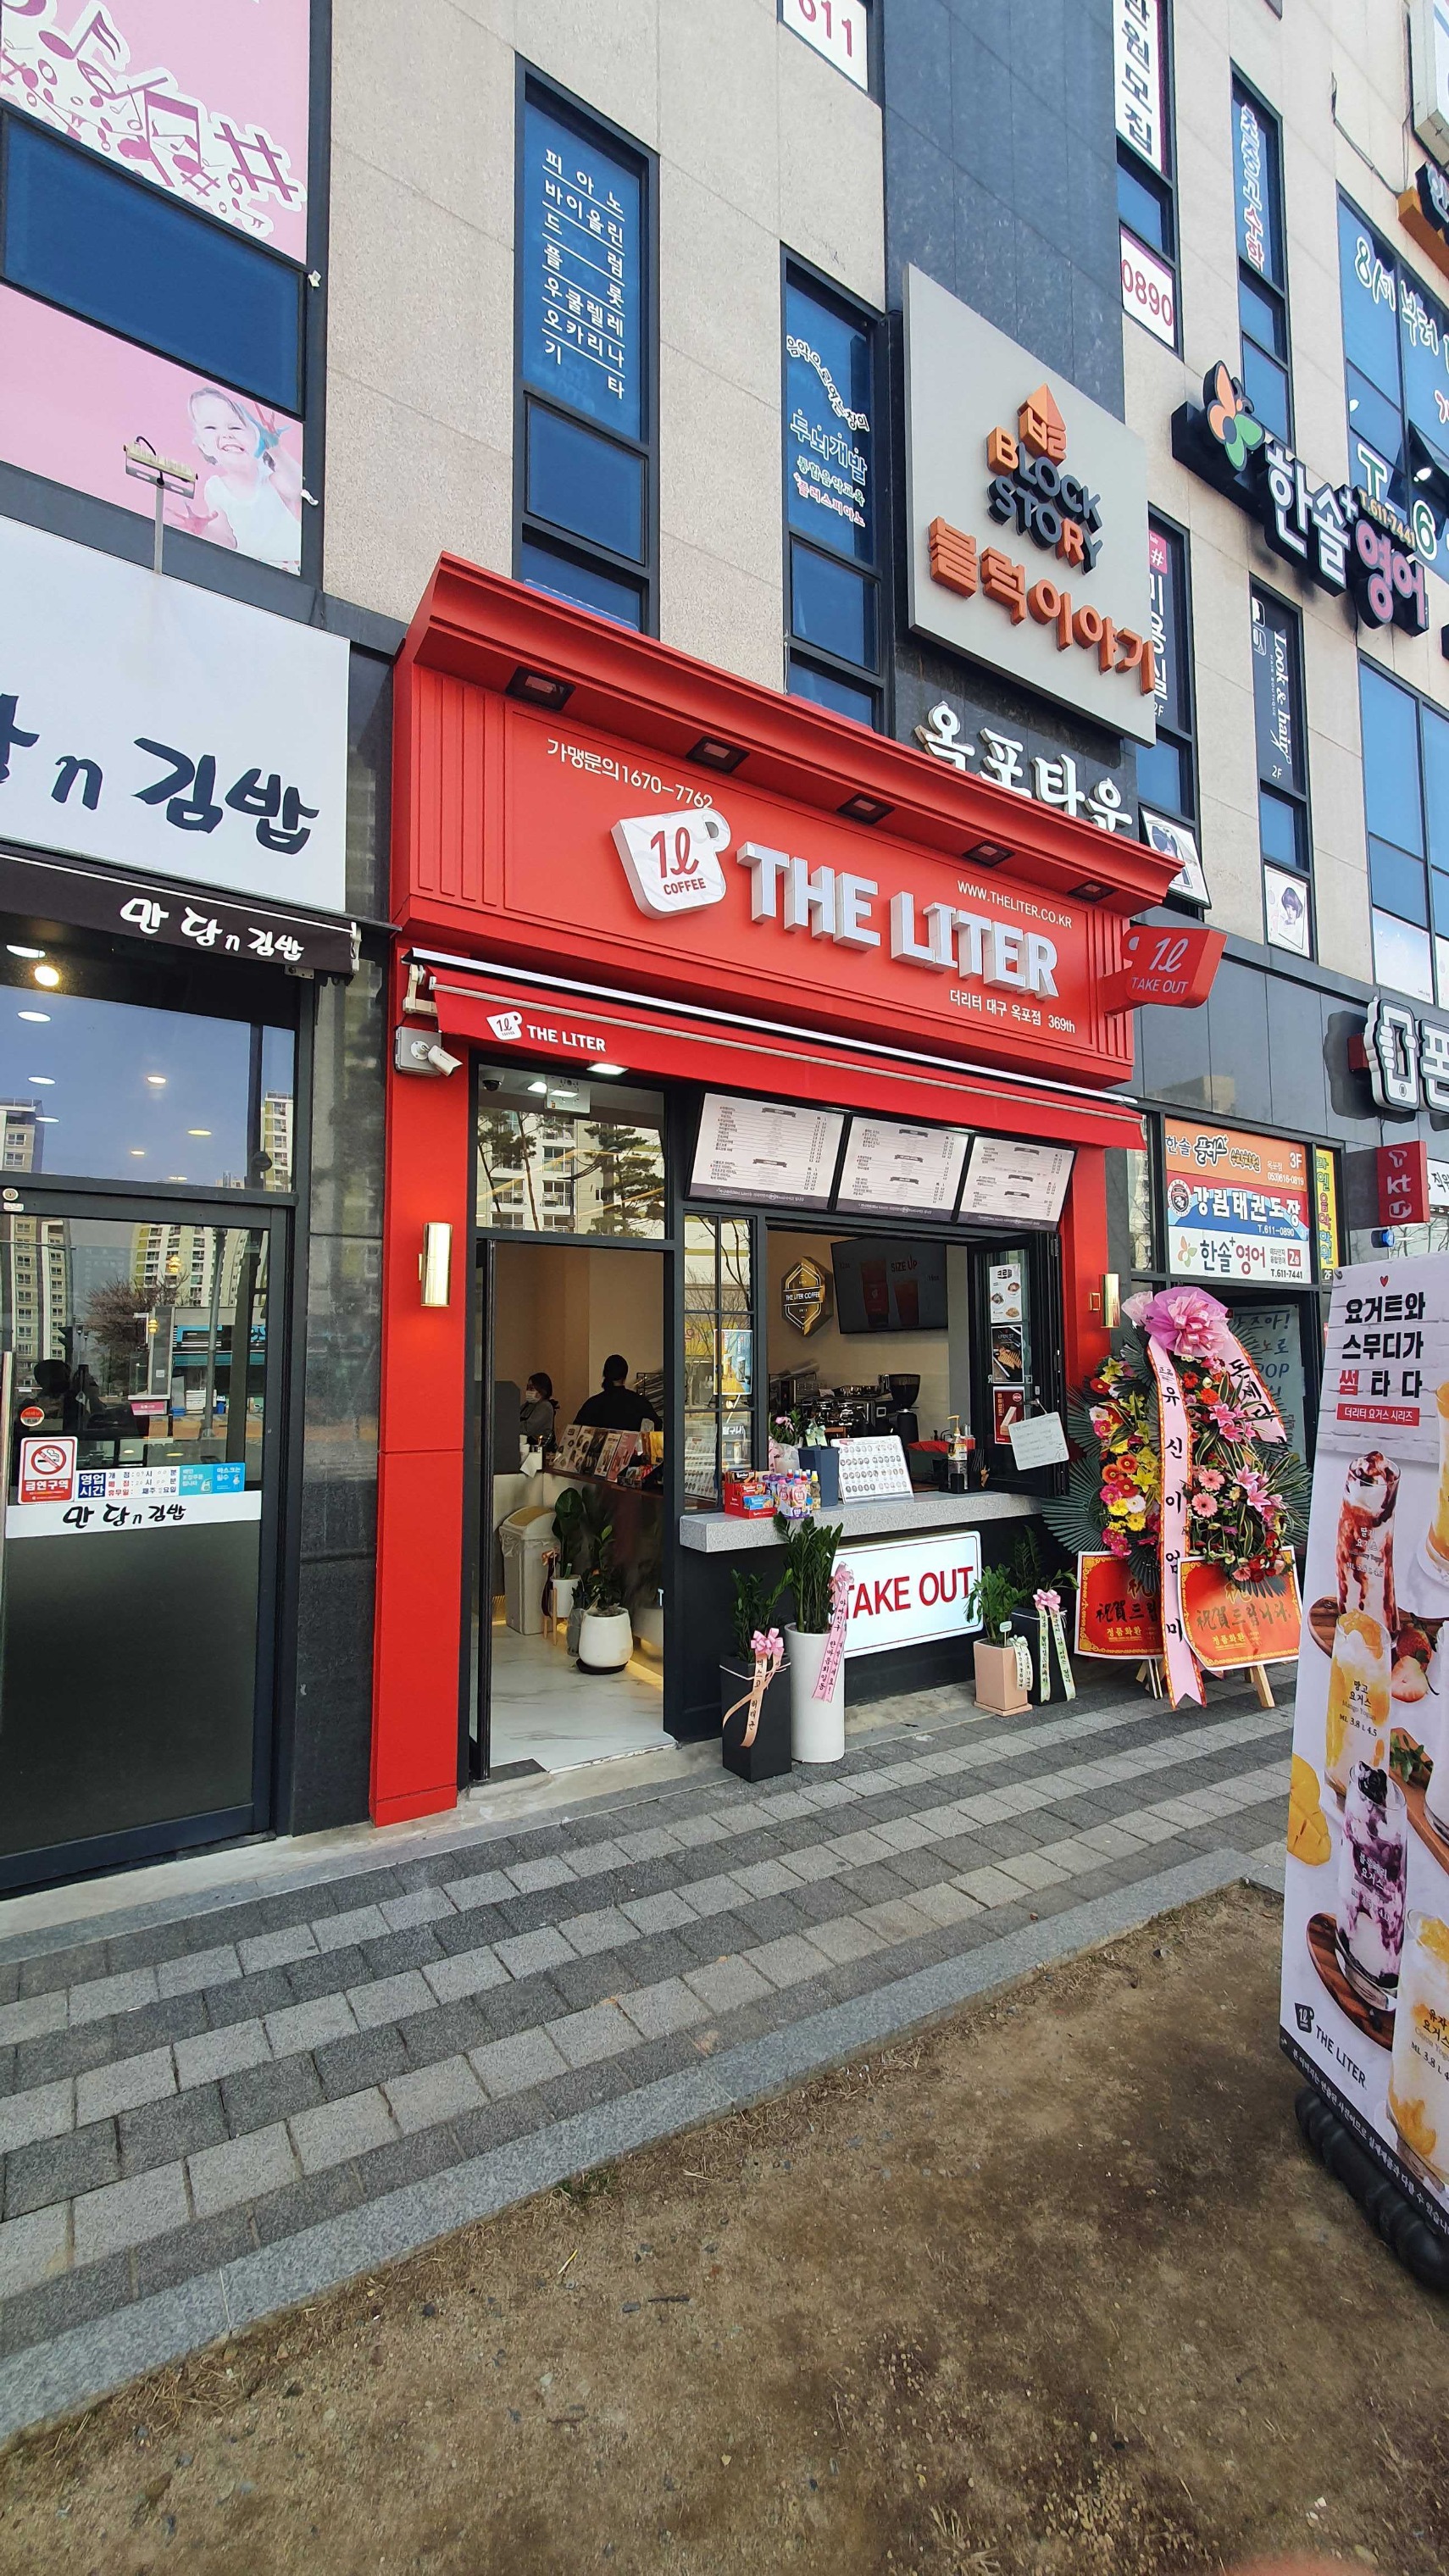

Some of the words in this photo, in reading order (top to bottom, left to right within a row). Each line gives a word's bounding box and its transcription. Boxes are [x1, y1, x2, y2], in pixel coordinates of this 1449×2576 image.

[545, 148, 624, 214] 피아노
[545, 180, 623, 247] 바이올린
[1121, 259, 1173, 327] 0890
[545, 310, 625, 369] 오카리나
[790, 408, 867, 486] 두뇌개발
[987, 426, 1102, 534] BLOCK
[988, 475, 1103, 575] STORY
[928, 516, 1155, 696] 블록이야기
[1274, 630, 1289, 686] Look
[1271, 765, 1283, 779] 2F
[131, 737, 320, 855] 김밥
[663, 877, 707, 896] COFFEE
[736, 841, 881, 952] THE
[890, 891, 1060, 1002] LITER
[957, 880, 1073, 930] WWW.THELITER.CO.KR
[1130, 976, 1161, 992] TAKE
[1162, 980, 1189, 995] OUT
[949, 989, 982, 1013] 더리터
[986, 999, 1008, 1019] 대구
[1011, 1005, 1042, 1027] 옥포점
[1047, 1014, 1076, 1034] 369th
[526, 1024, 558, 1044] THE
[562, 1032, 607, 1052] LITER
[1165, 1135, 1191, 1157] 한솔
[1290, 1152, 1303, 1169] 3F
[1386, 1174, 1412, 1195] kt
[891, 1261, 908, 1273] SIZE
[1270, 1269, 1303, 1279] T.611-7441
[1344, 1291, 1426, 1324] 요거트와
[1341, 1330, 1424, 1360] 스무디가
[1344, 1406, 1367, 1419] 더리터
[1368, 1408, 1390, 1421] 요거스
[1391, 1409, 1413, 1423] 시리즈
[25, 1479, 69, 1491] 금연구역
[79, 1485, 105, 1498] 시간
[80, 1473, 105, 1485] 영업
[919, 1566, 974, 1607] OUT
[1349, 1691, 1372, 1707] 요거스
[1353, 1680, 1368, 1694] 망고
[1429, 2008, 1447, 2031] 유자
[1316, 2024, 1335, 2055] THE
[1336, 2046, 1366, 2090] LITER
[1426, 2201, 1449, 2235] 있습니
